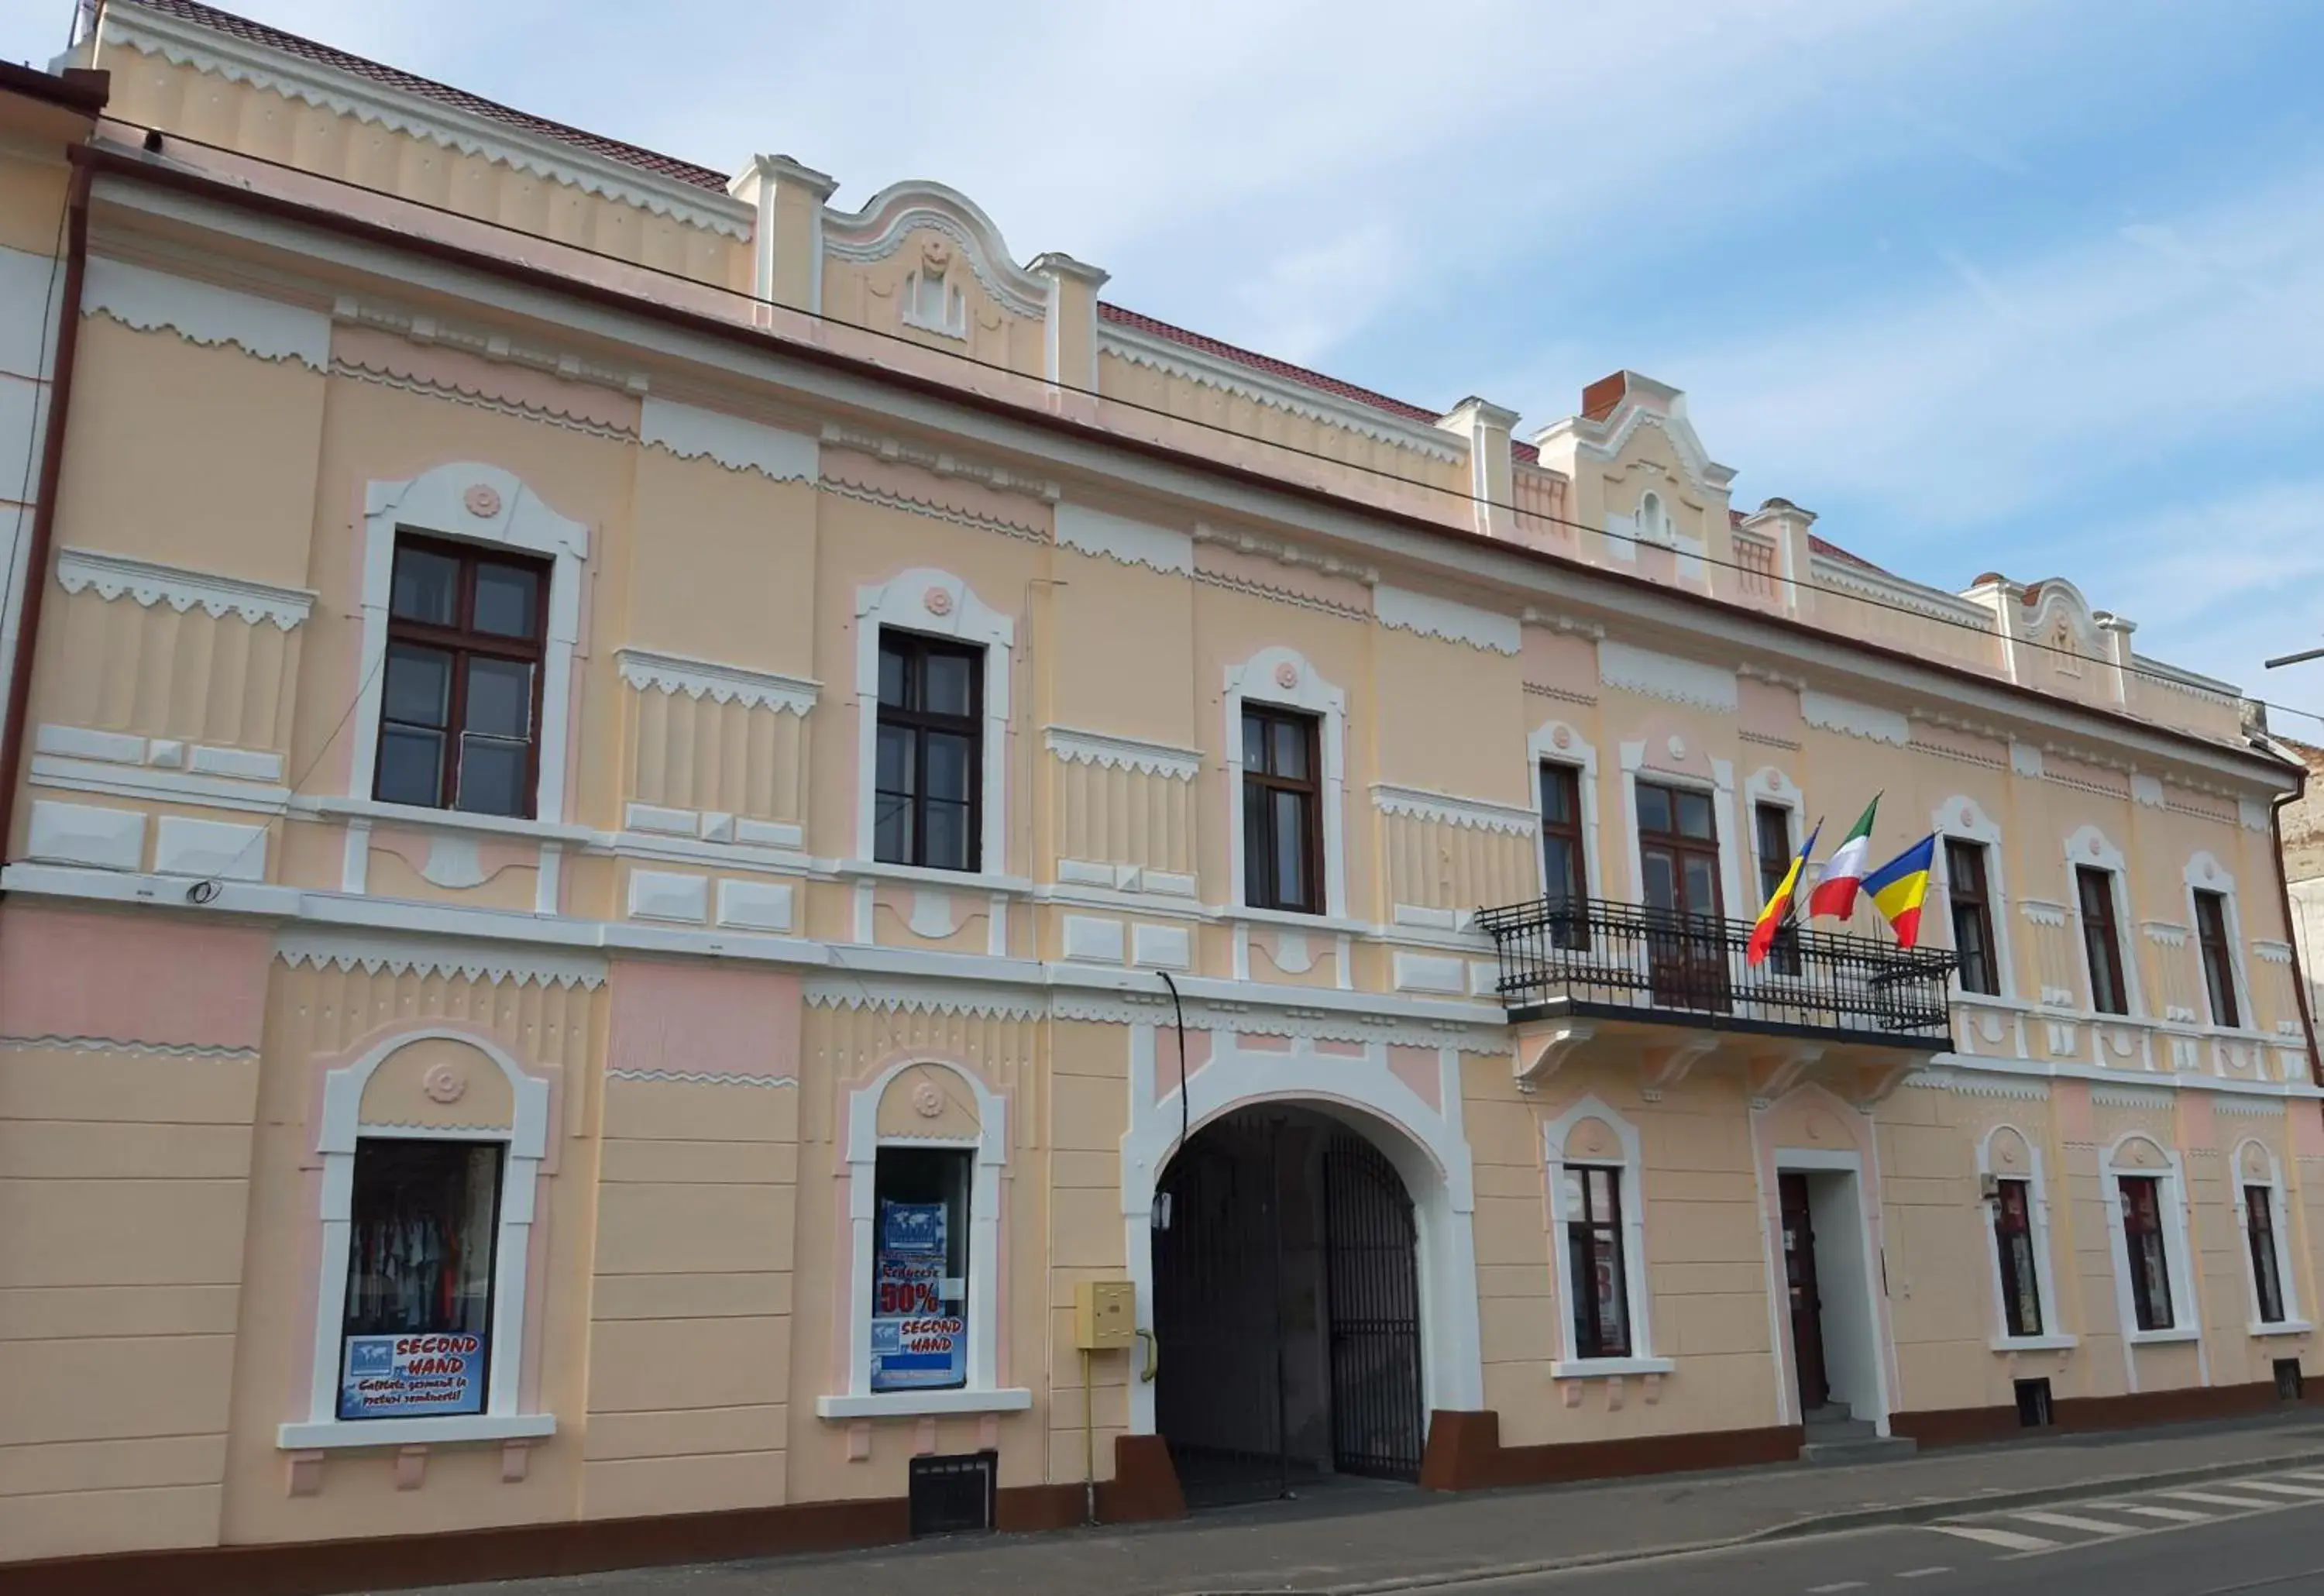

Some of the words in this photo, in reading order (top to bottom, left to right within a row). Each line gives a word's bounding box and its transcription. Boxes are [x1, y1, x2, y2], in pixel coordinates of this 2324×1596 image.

[881, 1282, 939, 1313] 50%
[901, 1319, 961, 1335] SECOND
[396, 1337, 478, 1355] SECOND
[910, 1336, 952, 1353] HAND
[407, 1357, 464, 1375] HAND
